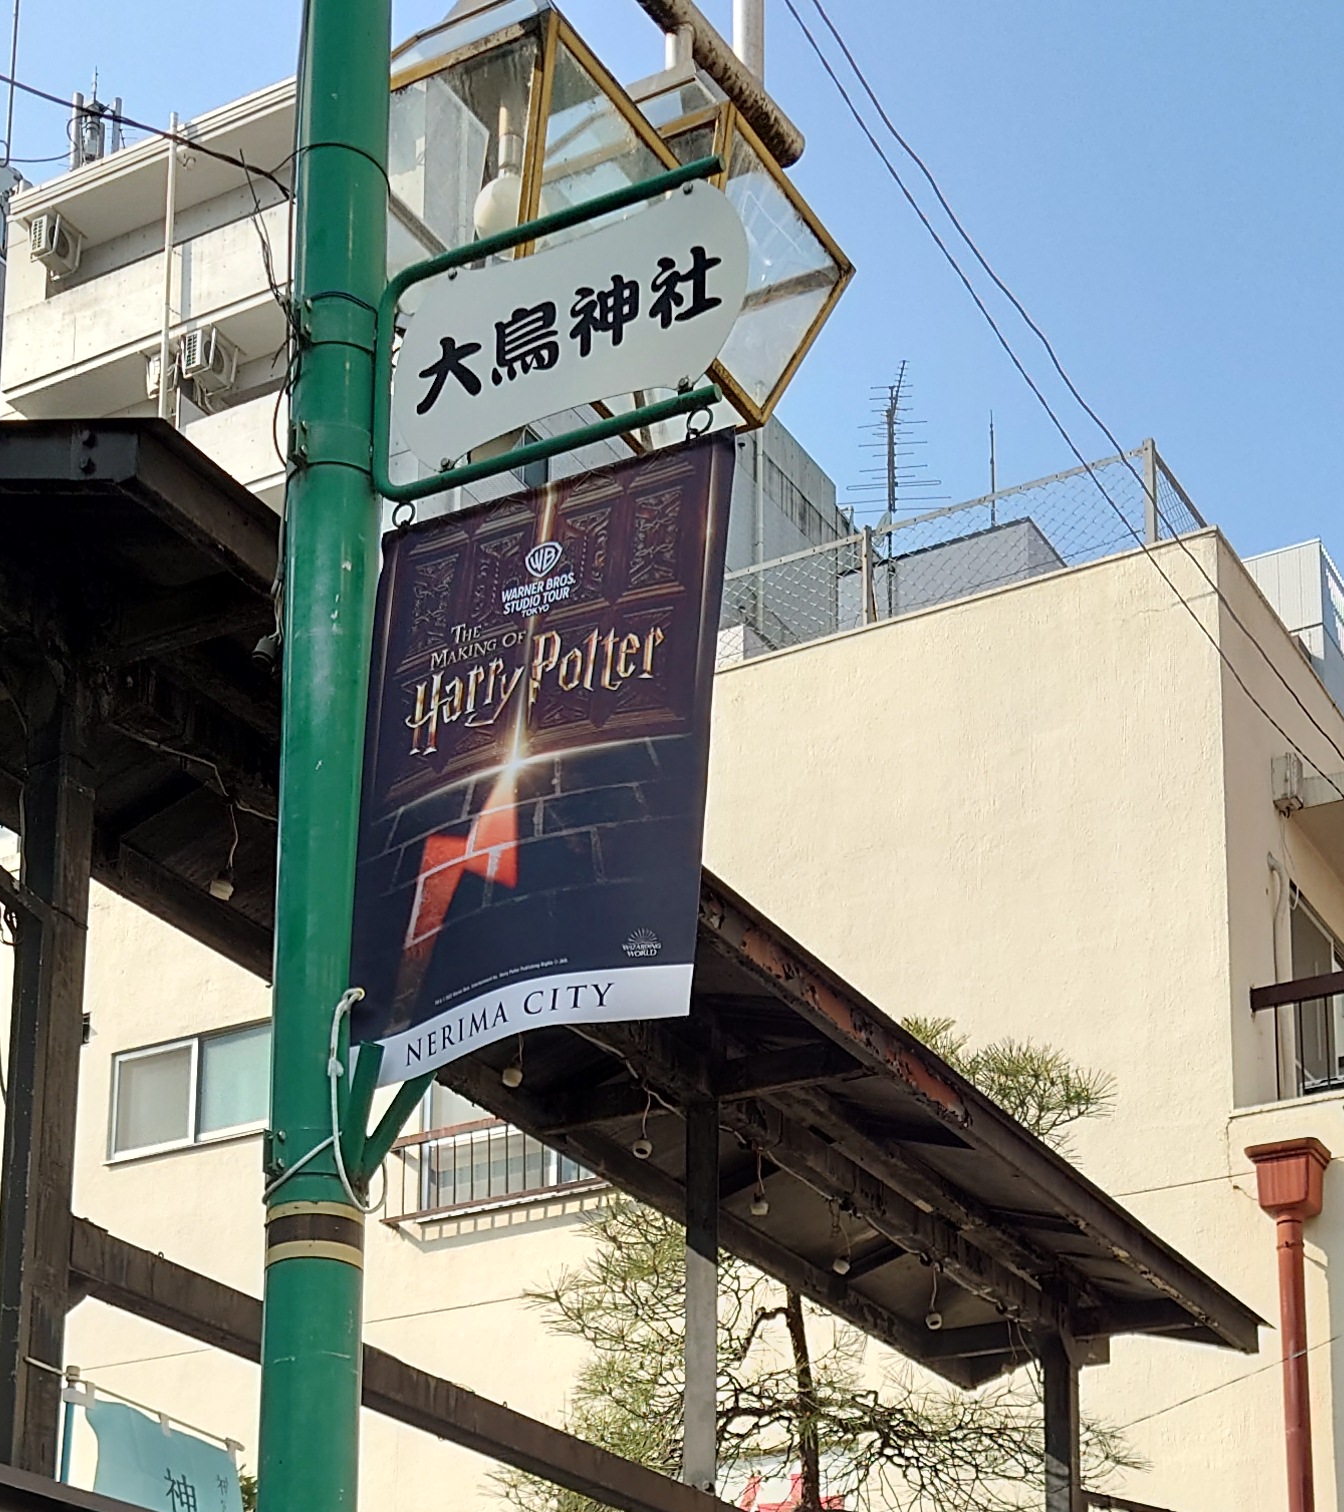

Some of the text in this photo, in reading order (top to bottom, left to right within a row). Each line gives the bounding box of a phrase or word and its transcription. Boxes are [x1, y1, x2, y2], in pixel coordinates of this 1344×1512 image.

[416, 245, 723, 416] 大鳥神社
[501, 571, 577, 603] WARNER BROS.
[502, 586, 570, 616] STUDIO TOUR
[521, 603, 550, 618] TOKYO
[405, 626, 666, 757] Harry Potter
[405, 1000, 510, 1068] NERIMA
[523, 982, 616, 1017] CITY
